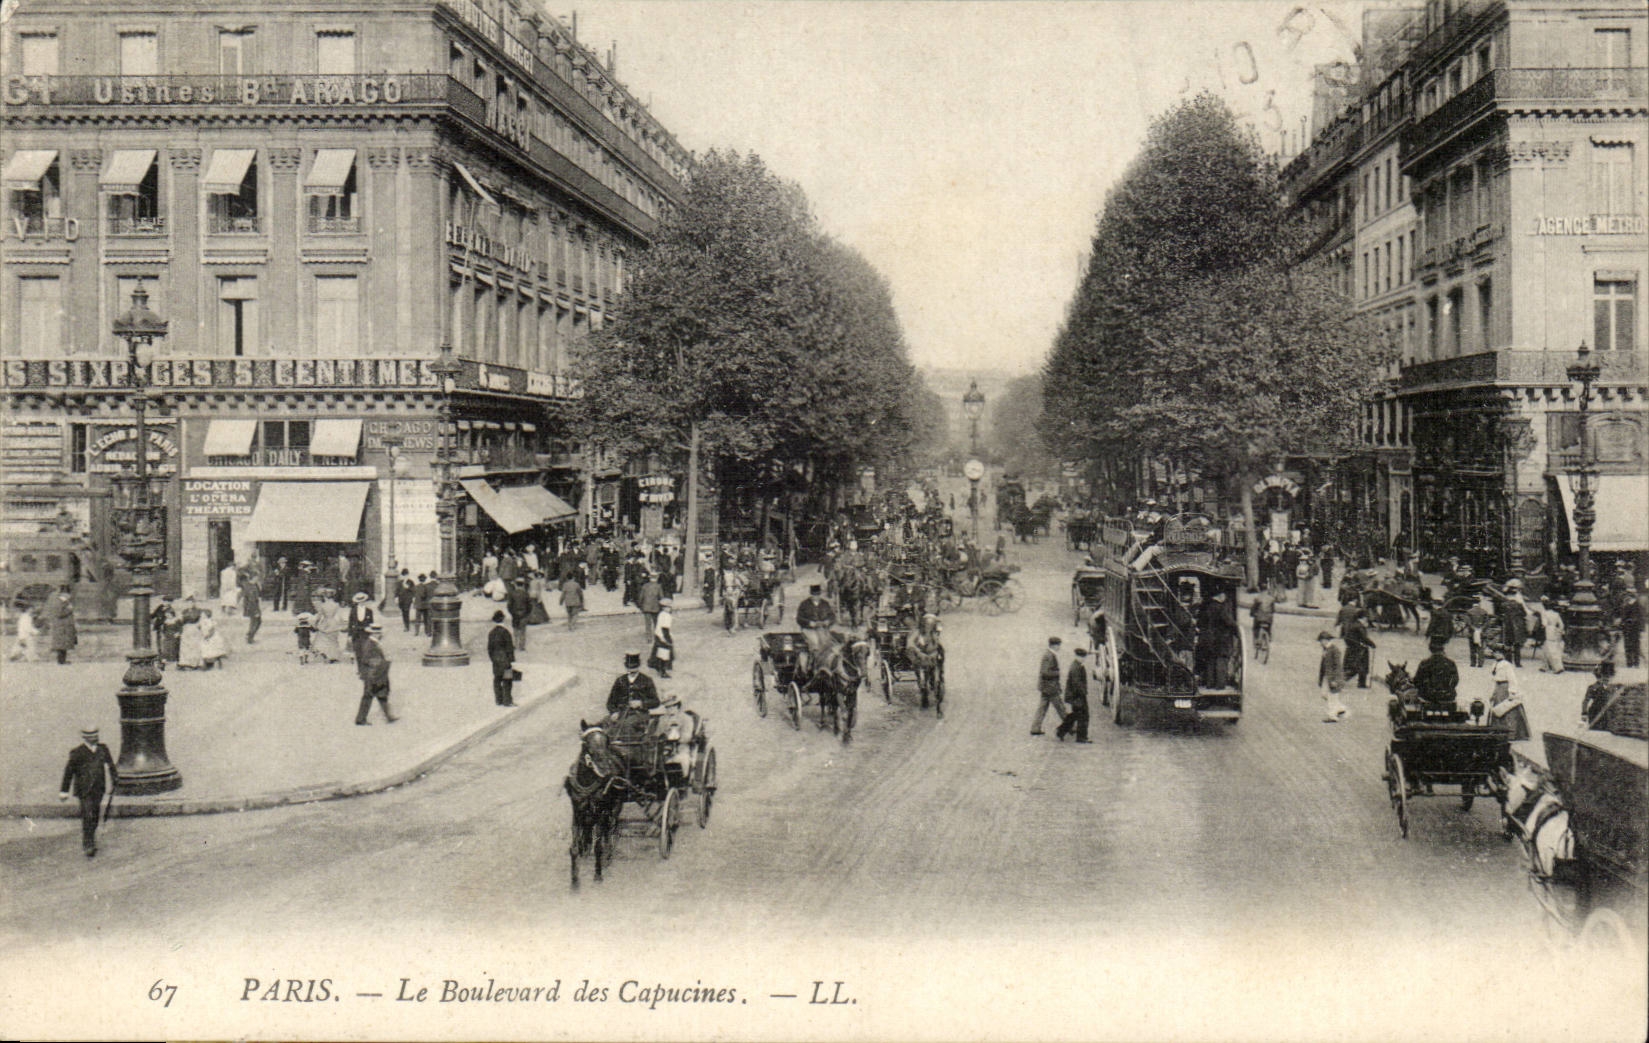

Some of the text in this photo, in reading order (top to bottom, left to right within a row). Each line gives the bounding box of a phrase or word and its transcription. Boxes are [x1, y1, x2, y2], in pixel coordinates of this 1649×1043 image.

[94, 78, 216, 104] Usines
[290, 77, 401, 104] ARAGO
[1538, 215, 1590, 235] AGENCE
[275, 360, 438, 386] CENTIMES
[149, 431, 178, 457] PARIS
[269, 449, 302, 466] DAILY
[184, 481, 251, 492] LOCATION
